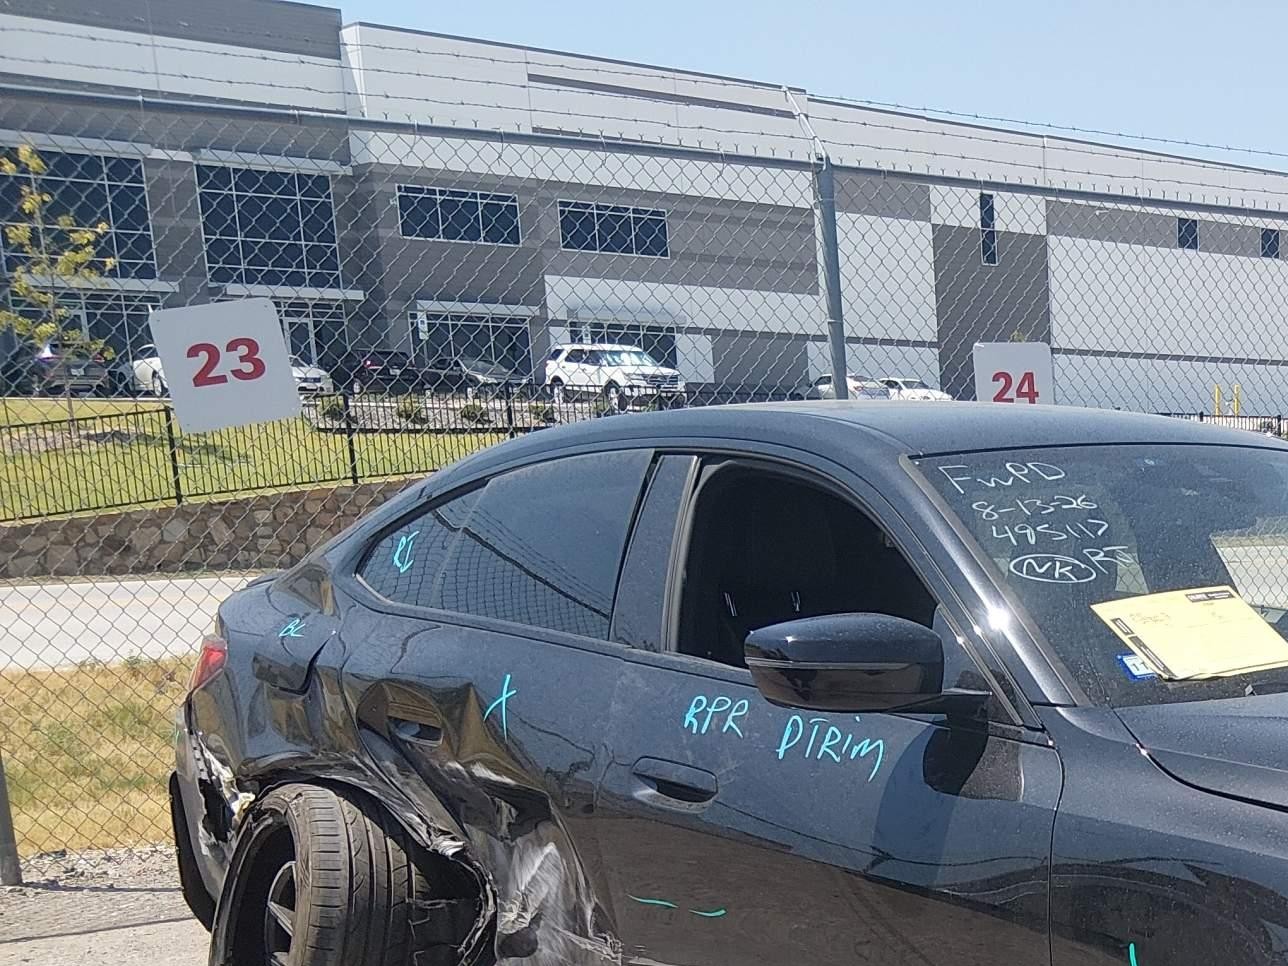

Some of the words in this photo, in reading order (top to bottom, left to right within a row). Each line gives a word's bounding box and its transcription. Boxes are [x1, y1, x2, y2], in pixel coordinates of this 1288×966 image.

[187, 337, 266, 388] 23
[991, 371, 1039, 404] 24
[684, 696, 748, 739] RPR
